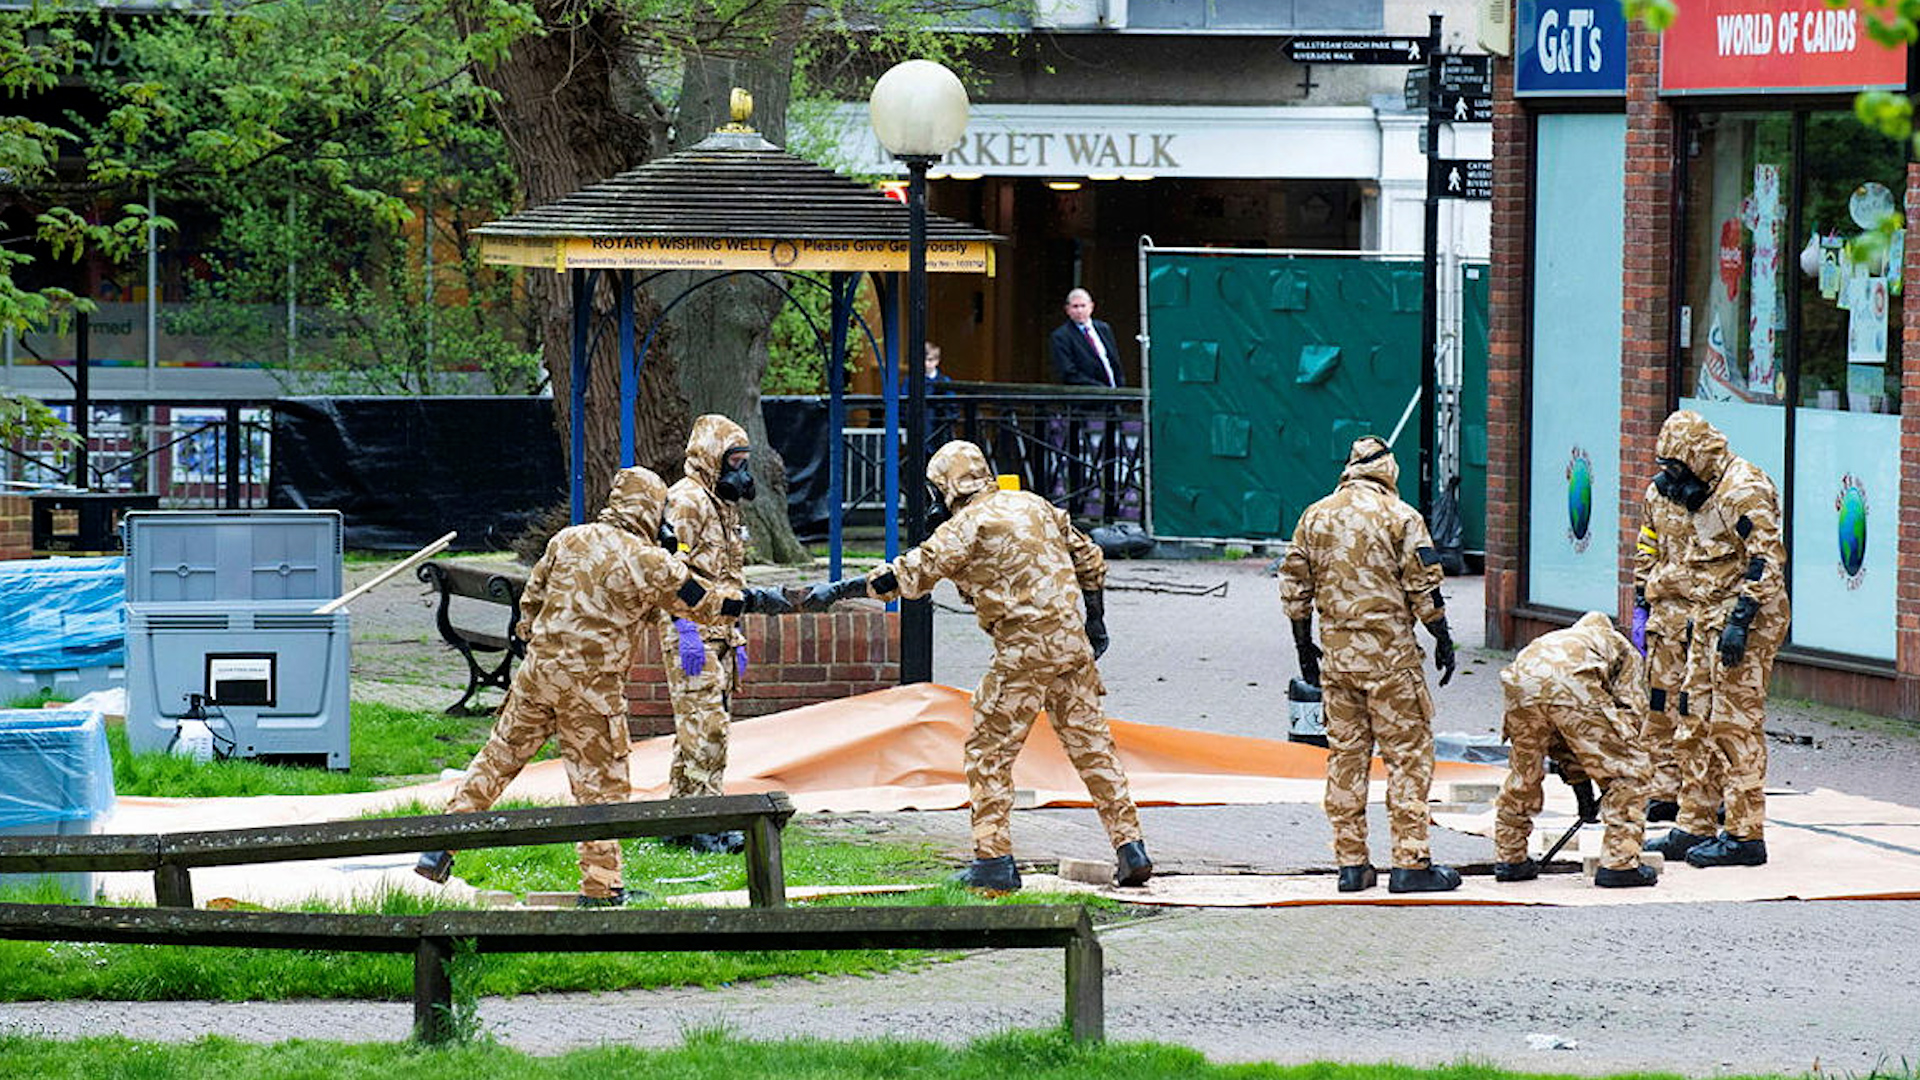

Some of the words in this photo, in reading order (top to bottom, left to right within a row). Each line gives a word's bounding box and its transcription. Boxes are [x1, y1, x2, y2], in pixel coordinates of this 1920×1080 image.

[1537, 8, 1602, 74] G&T's
[1716, 13, 1773, 56] WORLD
[1777, 12, 1799, 54] OF
[1802, 9, 1858, 53] CARDS
[1333, 52, 1354, 60] WALK
[1064, 133, 1181, 168] WALK
[593, 238, 652, 250] ROTARY
[659, 238, 722, 250] WISHING
[727, 239, 767, 251] WELL
[803, 240, 849, 251] Please
[853, 240, 883, 251] Give
